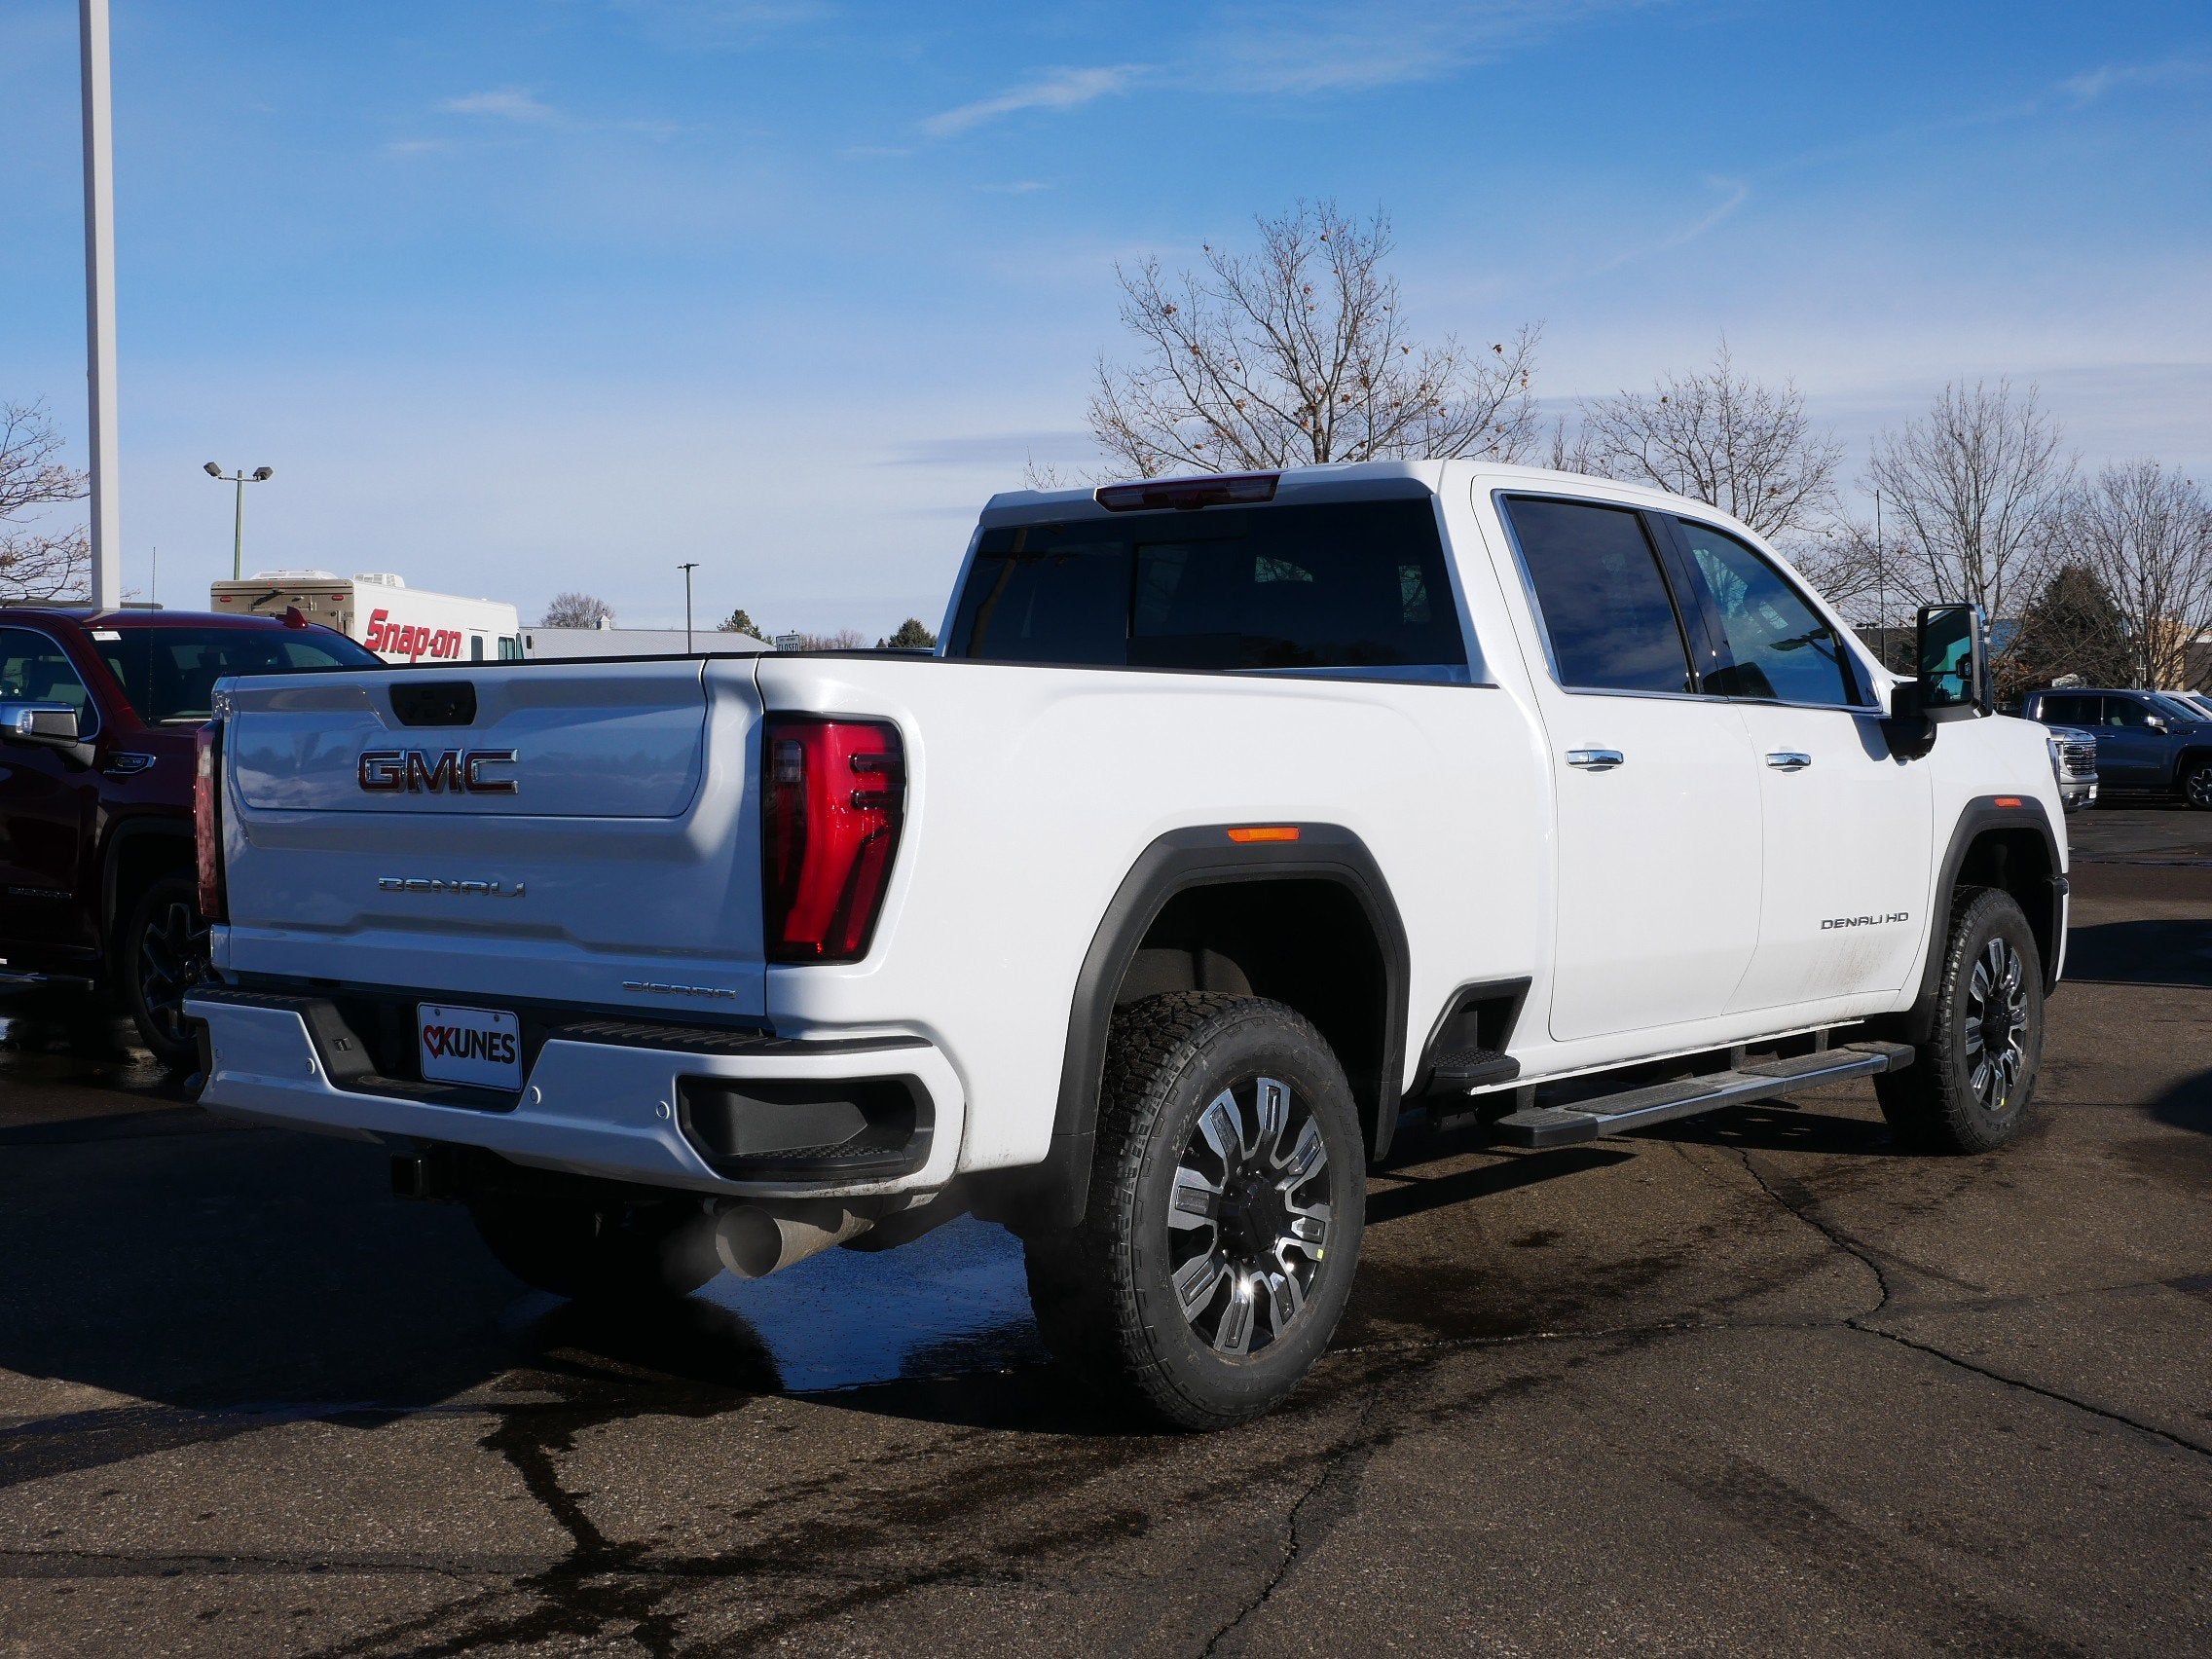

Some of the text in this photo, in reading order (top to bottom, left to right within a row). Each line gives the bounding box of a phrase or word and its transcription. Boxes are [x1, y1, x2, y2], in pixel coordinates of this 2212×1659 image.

[364, 608, 462, 663] Snap-on
[358, 749, 518, 794] GMC
[378, 876, 527, 898] DENALI
[1820, 912, 1909, 930] DENALI HD
[438, 1025, 516, 1065] KUNES
